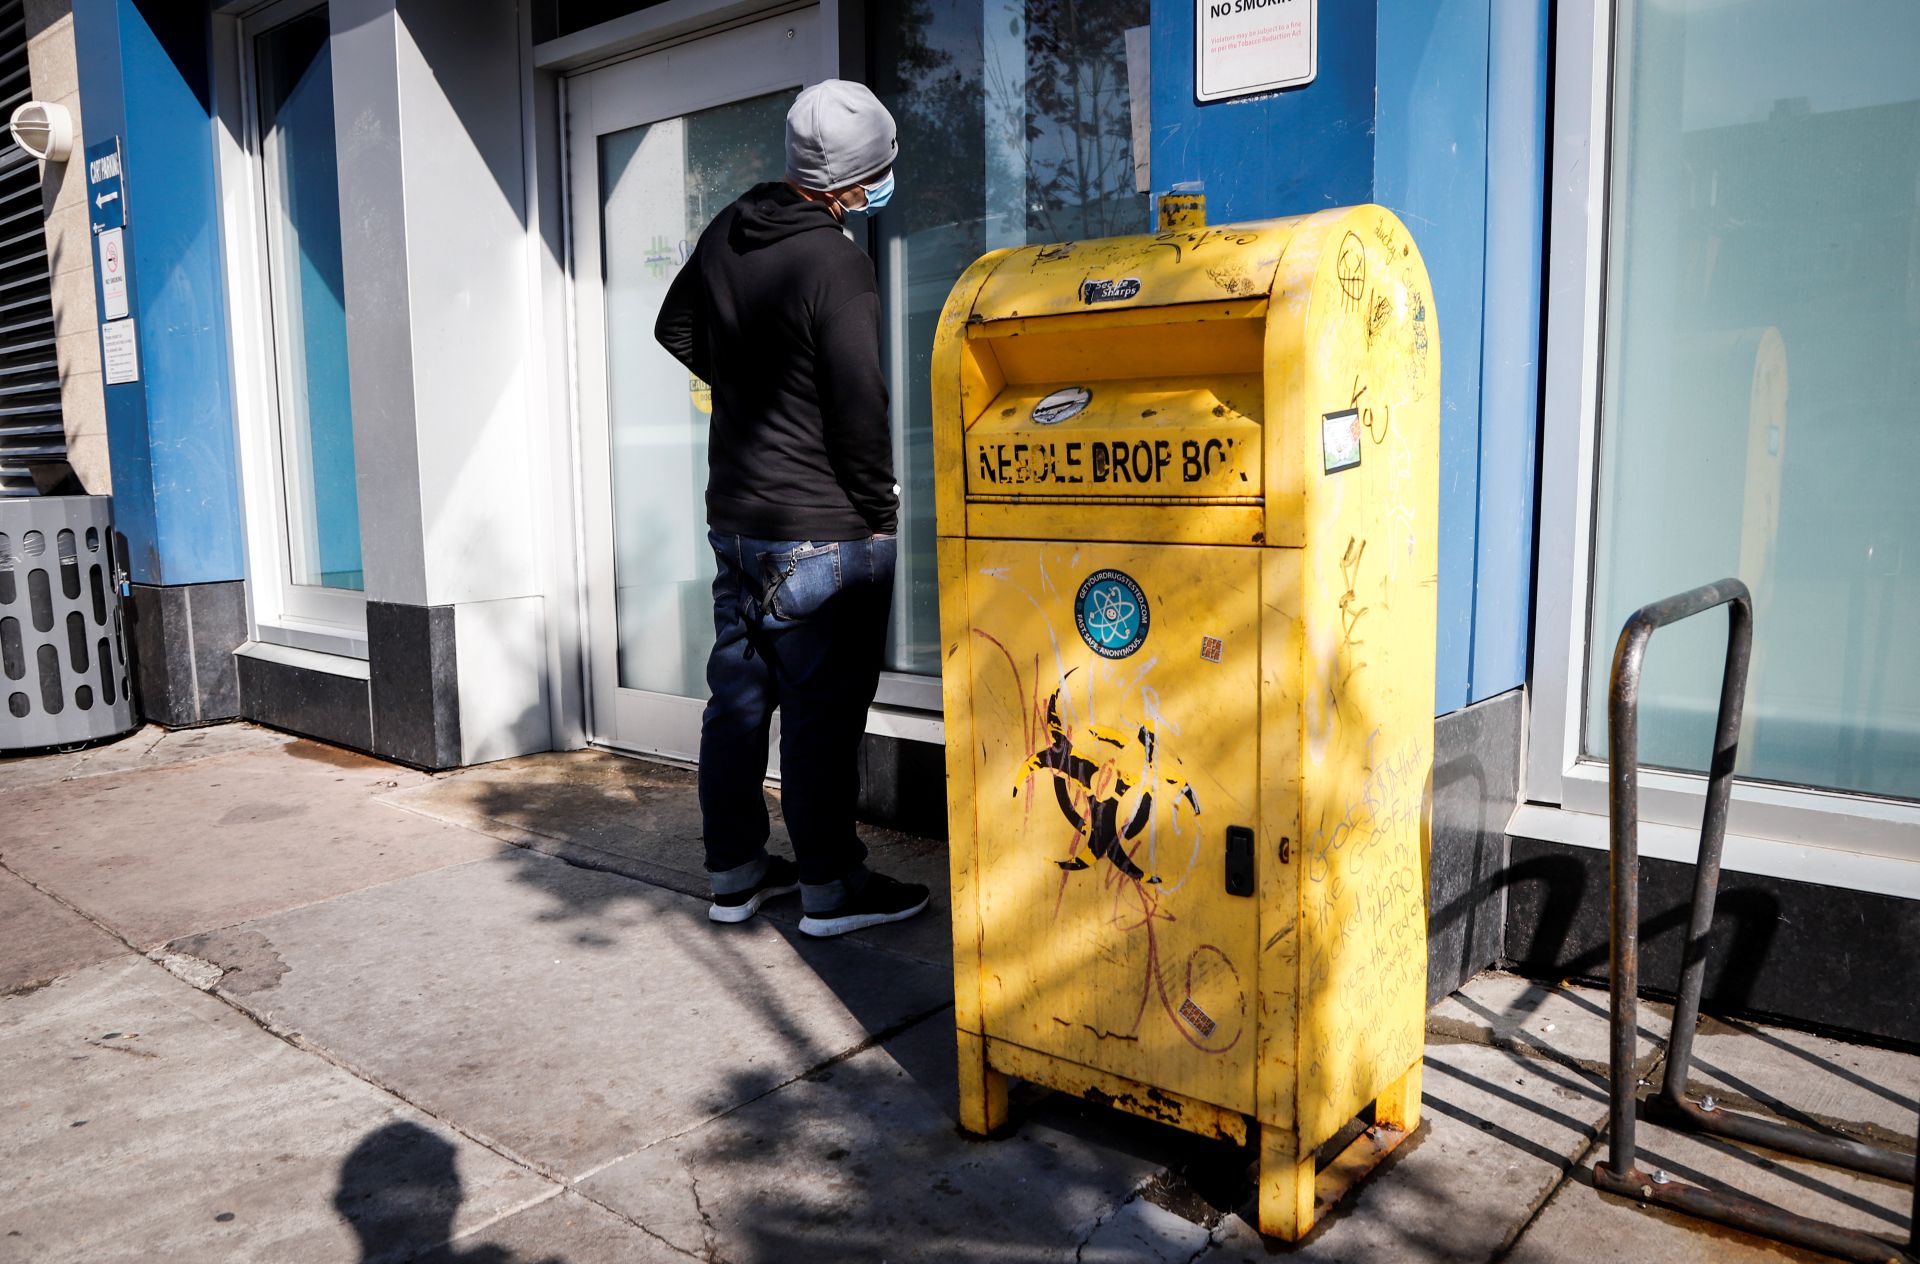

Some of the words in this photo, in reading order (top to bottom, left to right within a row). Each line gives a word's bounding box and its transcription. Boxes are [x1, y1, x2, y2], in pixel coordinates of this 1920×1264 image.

[1210, 2, 1231, 19] NO
[1235, 0, 1292, 13] SMOK
[1236, 33, 1248, 41] may
[1257, 25, 1278, 36] subject
[1290, 21, 1302, 29] fine
[1262, 32, 1291, 43] Reduction
[1095, 280, 1128, 290] Secre
[1101, 287, 1137, 298] Sharps
[979, 442, 1083, 484] NEEDLE
[1092, 439, 1173, 483] DROP
[1080, 572, 1147, 624] GETYOURDRUGSTESTED.COM
[1076, 613, 1086, 634] FAST.
[1100, 637, 1142, 657] ANONYMOUS.
